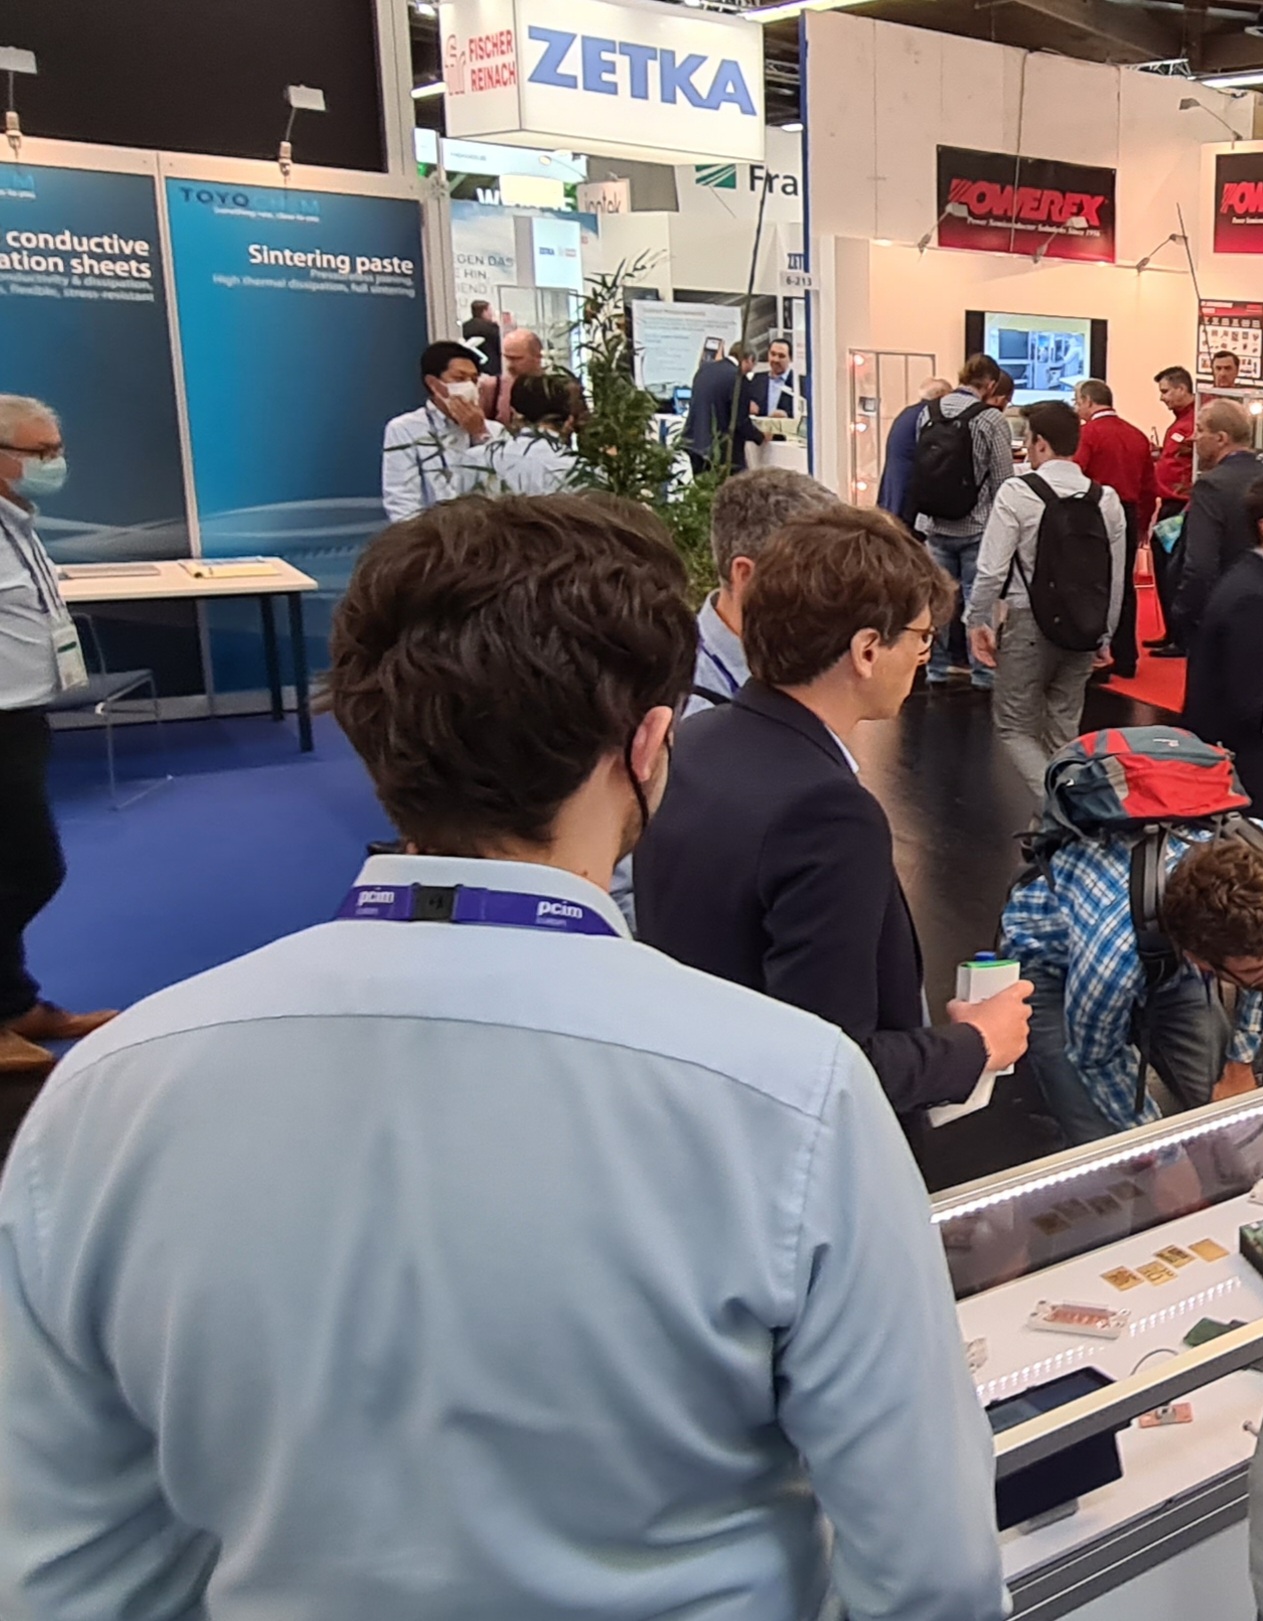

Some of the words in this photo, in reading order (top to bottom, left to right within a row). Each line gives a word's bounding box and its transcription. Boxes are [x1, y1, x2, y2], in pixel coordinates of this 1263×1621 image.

[469, 30, 513, 62] FISCHER
[471, 61, 516, 92] REINACH
[528, 25, 757, 116] ZETKA
[749, 164, 799, 196] Fra
[948, 178, 1105, 226] POWEREX
[6, 229, 149, 256] conductive
[0, 250, 64, 272] ation
[70, 253, 152, 278] sheets
[248, 244, 350, 273] Sintering
[356, 256, 413, 275] paste
[488, 255, 514, 267] DAS
[357, 887, 395, 906] pcim
[537, 900, 583, 919] pcim
